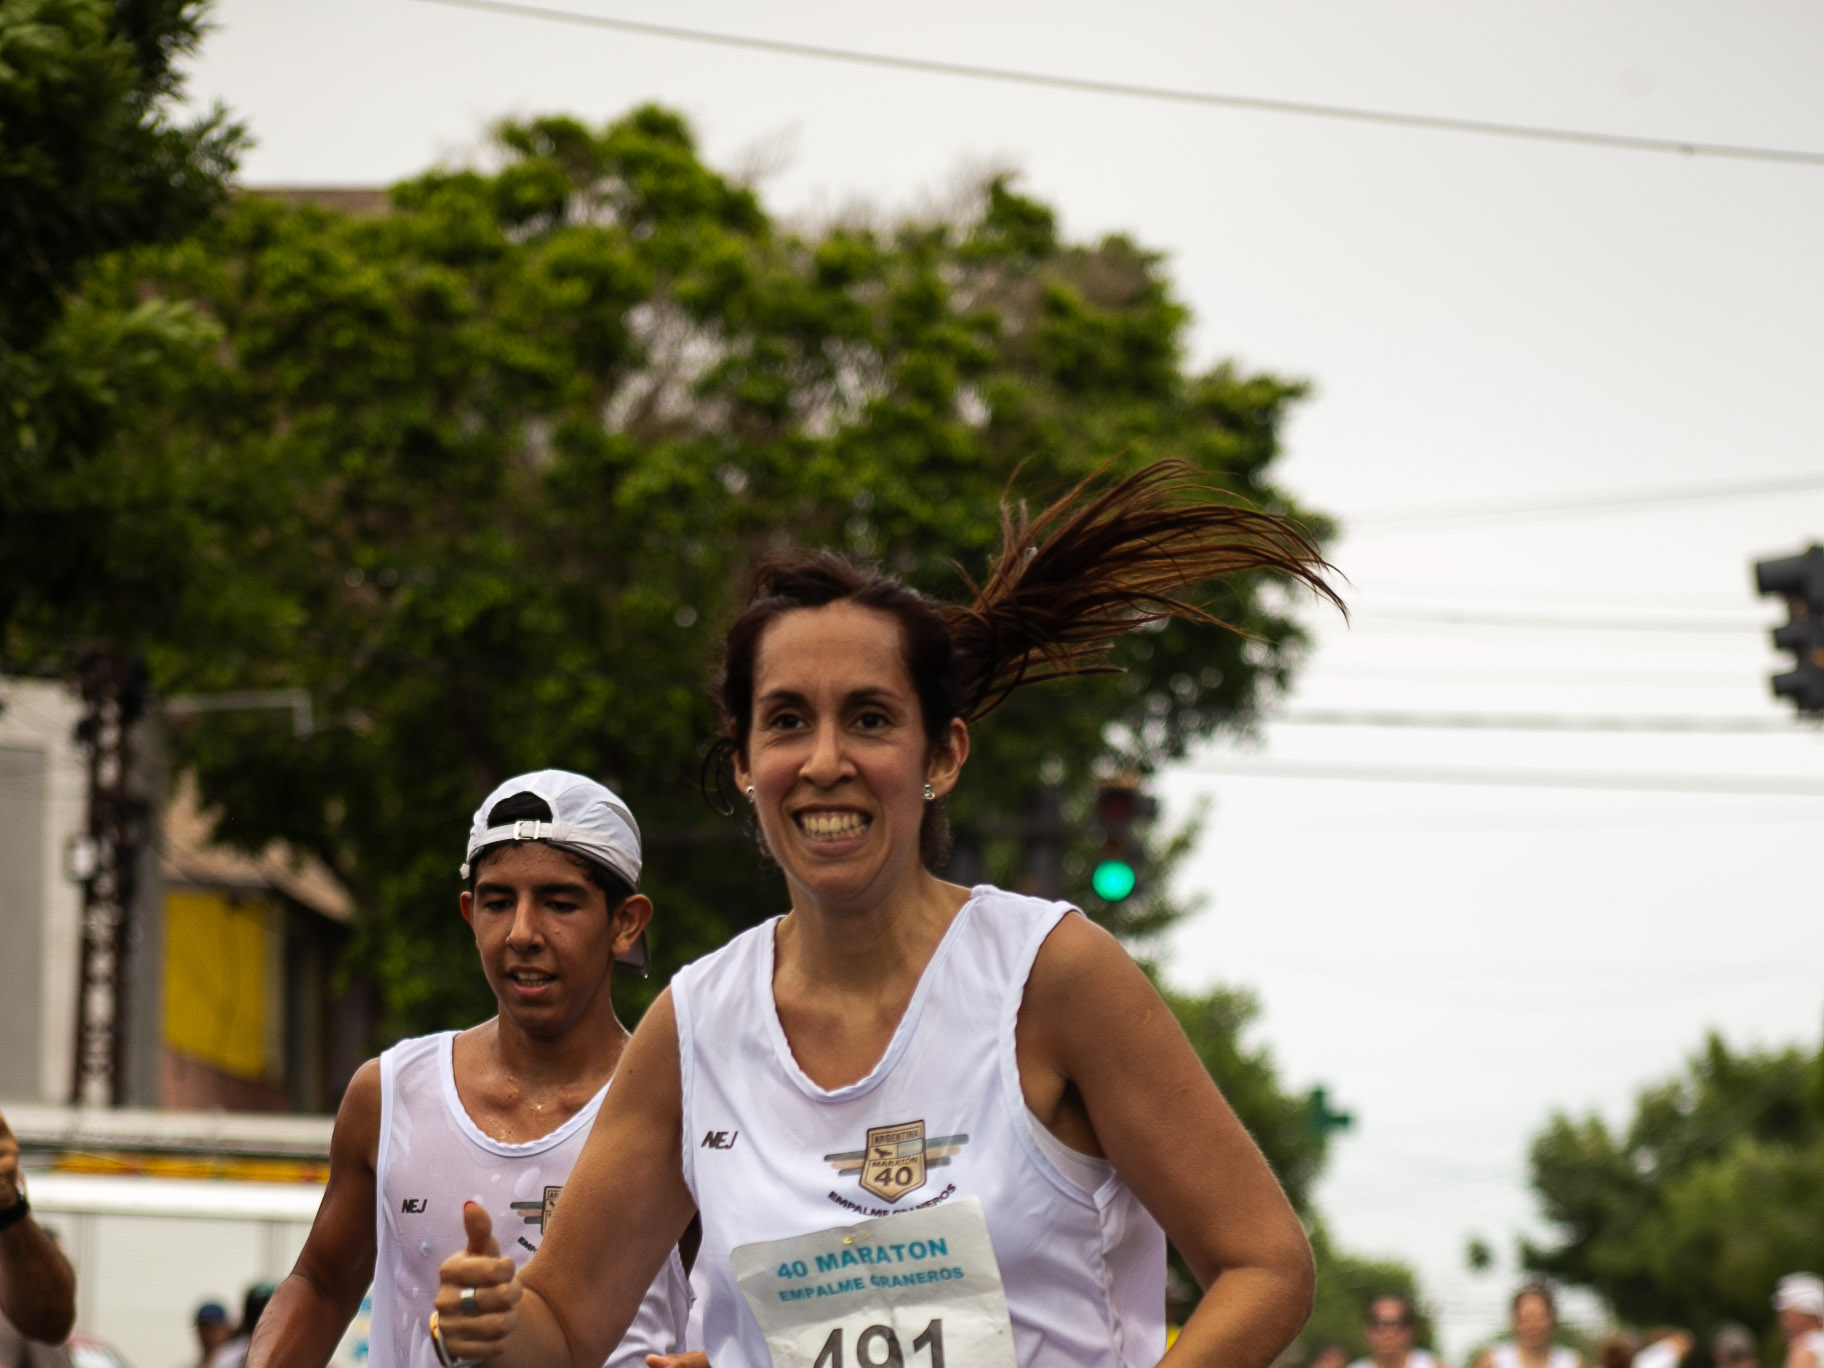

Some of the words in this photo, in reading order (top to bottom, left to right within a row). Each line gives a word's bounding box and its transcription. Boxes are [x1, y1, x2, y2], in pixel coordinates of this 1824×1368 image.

[701, 1131, 738, 1149] NEJ
[874, 1166, 913, 1187] 40
[402, 1199, 427, 1213] NEJ
[828, 1190, 889, 1217] EMPALME
[777, 1260, 808, 1279] 40
[815, 1237, 949, 1273] MARATON
[778, 1277, 865, 1301] EMPALME
[869, 1267, 964, 1288] GRANEROS
